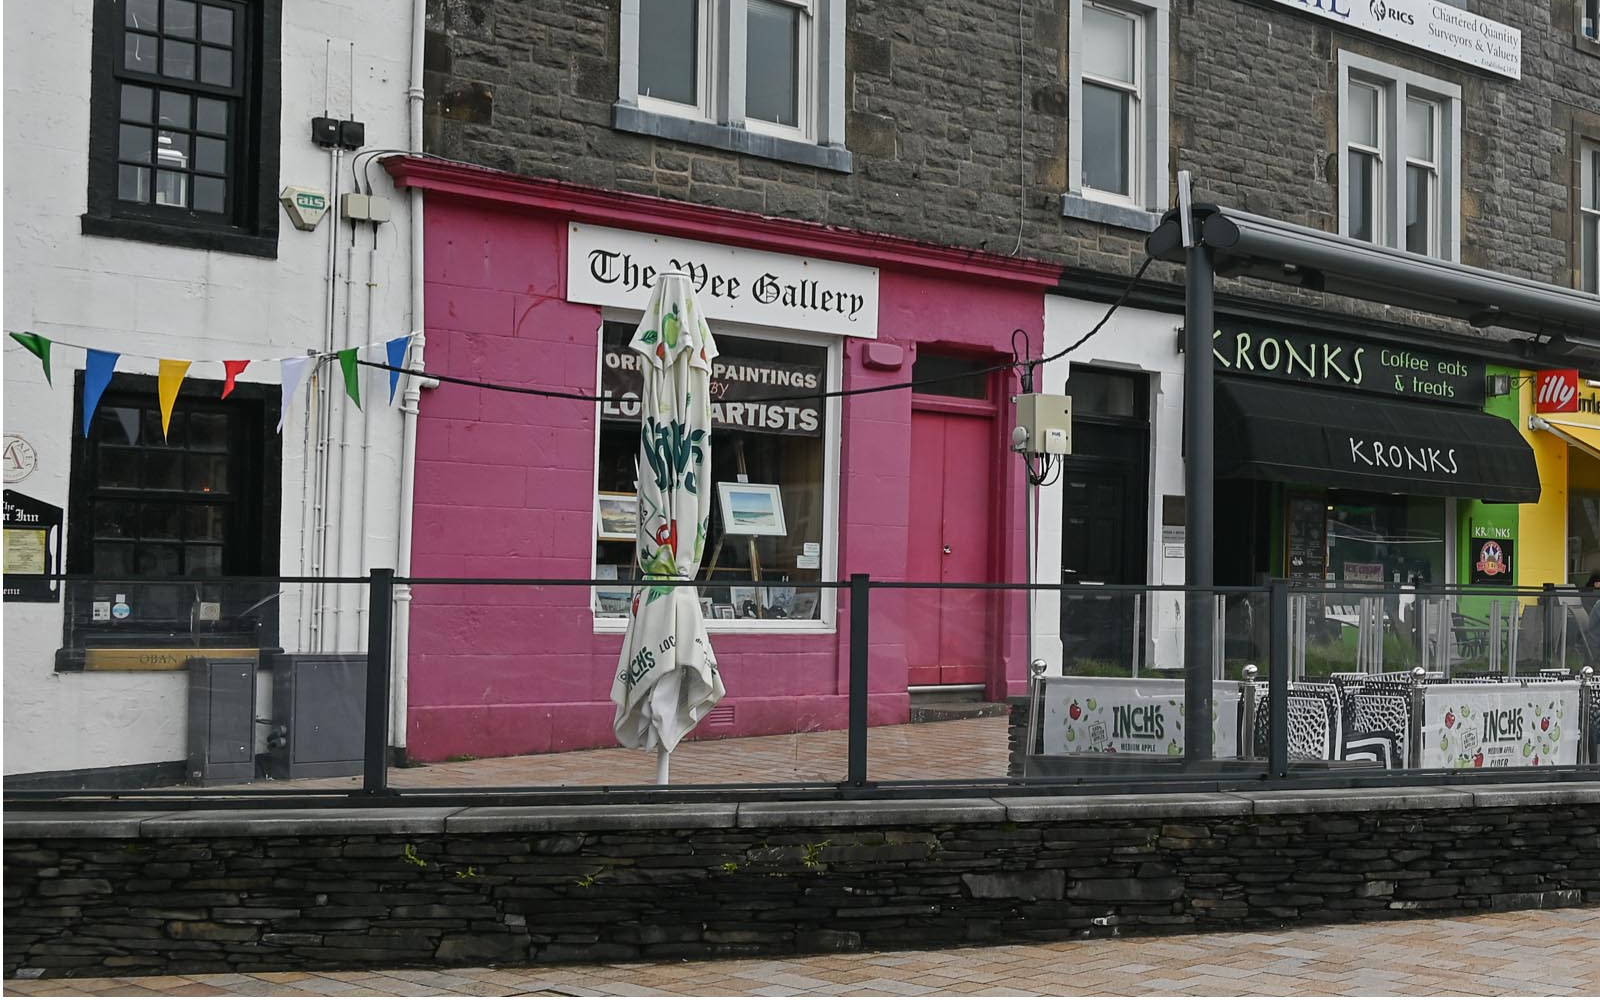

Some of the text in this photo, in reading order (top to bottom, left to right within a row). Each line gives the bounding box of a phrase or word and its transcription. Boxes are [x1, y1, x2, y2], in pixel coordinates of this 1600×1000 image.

[1388, 7, 1415, 26] RICS
[1432, 5, 1519, 50] Chartered Quantity
[1428, 23, 1519, 63] Surveyors & Valuers
[588, 249, 656, 293] The
[752, 272, 864, 322] Gallery
[1381, 350, 1429, 371] Coffee
[1437, 360, 1468, 377] eats
[713, 363, 818, 389] PAINTINGS
[1394, 375, 1454, 398] & treats
[1539, 375, 1575, 410] illy
[710, 402, 819, 432] ARTISTS
[1350, 437, 1458, 474] KRONKS
[3, 501, 15, 512] he
[15, 509, 39, 522] Inn
[3, 587, 20, 595] enu
[139, 654, 178, 665] OBAN
[1121, 743, 1156, 752] MEDIUM APPLE
[1488, 746, 1514, 754] MEDIUM APPLE
